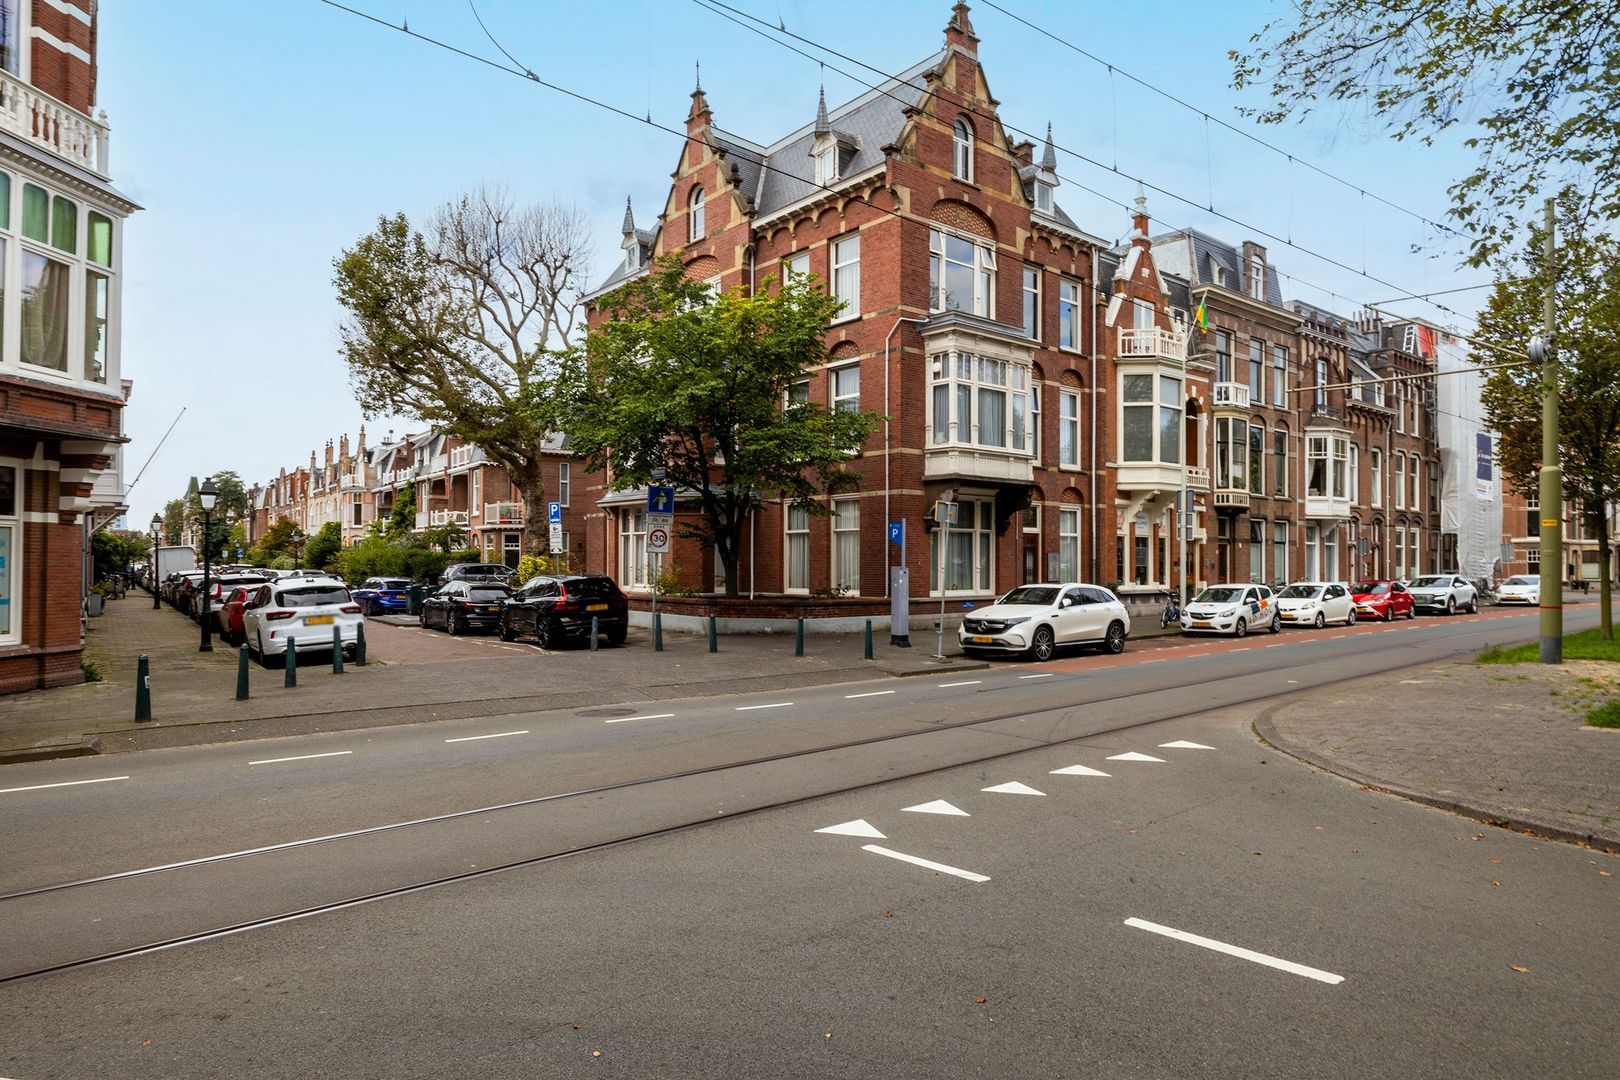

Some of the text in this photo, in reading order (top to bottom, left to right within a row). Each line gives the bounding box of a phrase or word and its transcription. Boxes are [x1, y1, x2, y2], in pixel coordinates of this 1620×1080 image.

[551, 504, 558, 516] P
[653, 534, 665, 542] 30
[892, 528, 899, 538] P
[1249, 607, 1273, 625] AD HOC
